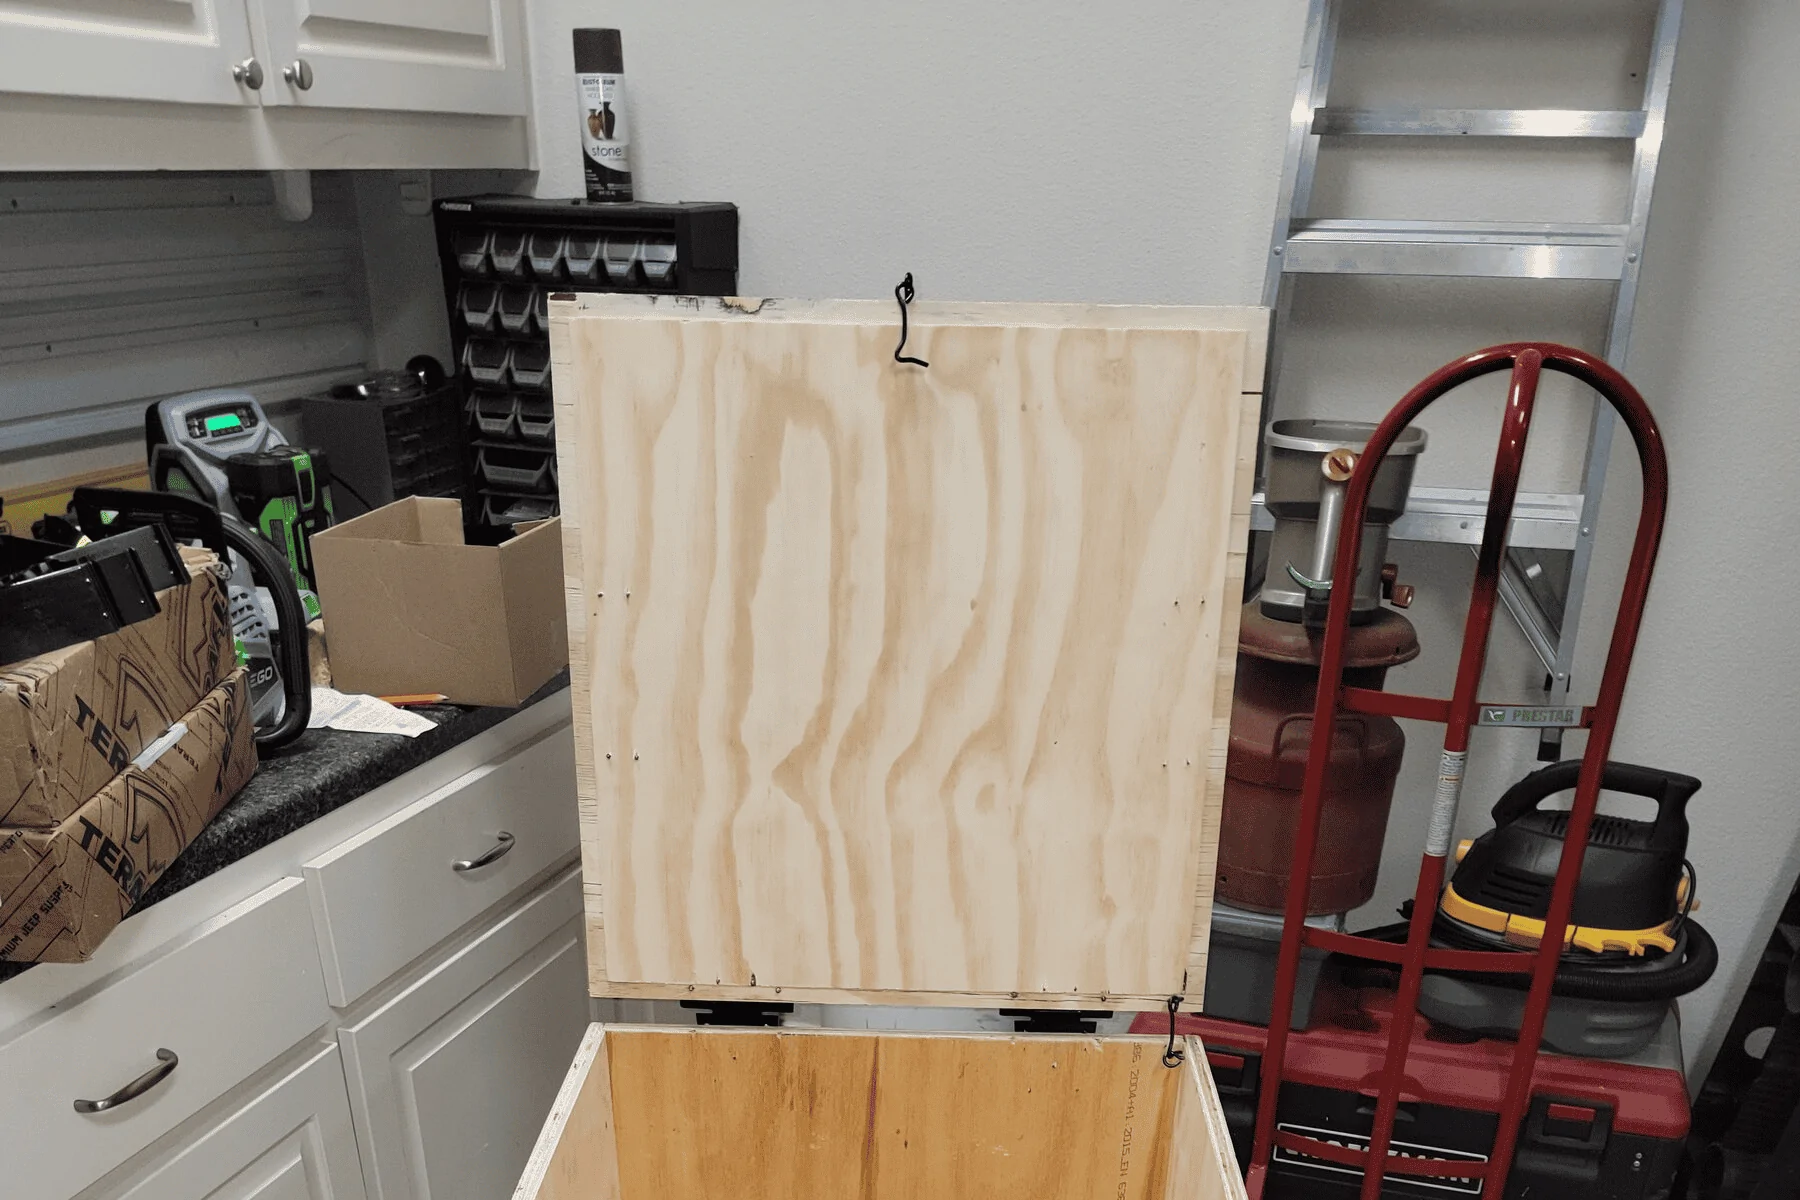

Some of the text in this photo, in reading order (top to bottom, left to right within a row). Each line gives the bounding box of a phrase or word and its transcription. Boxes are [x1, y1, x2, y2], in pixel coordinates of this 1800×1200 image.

[592, 145, 622, 157] stone
[249, 665, 273, 689] EGO
[22, 912, 41, 936] JEEP
